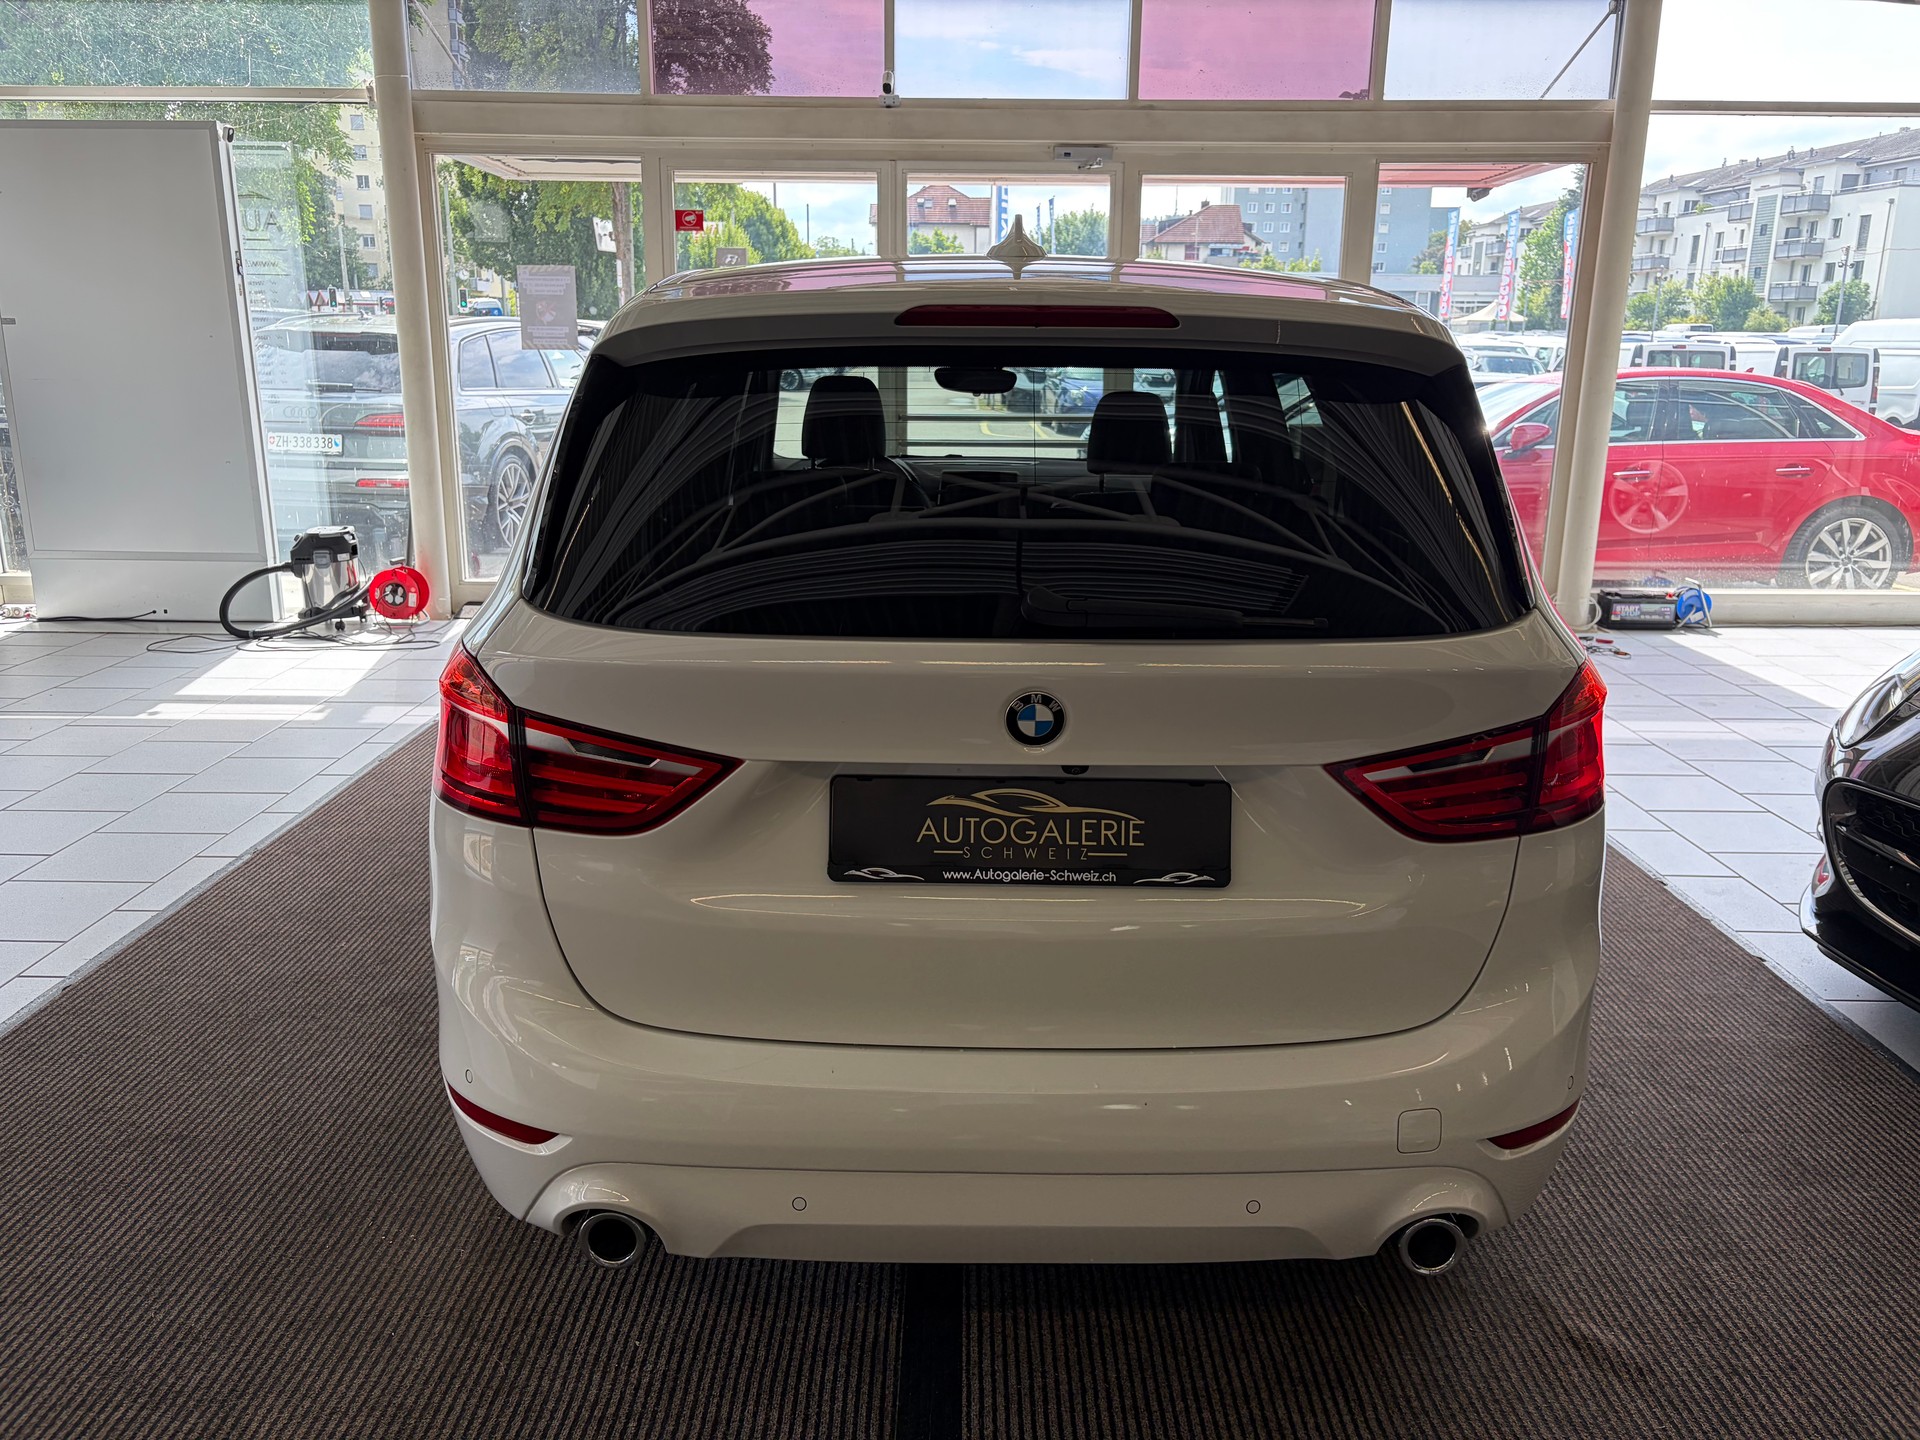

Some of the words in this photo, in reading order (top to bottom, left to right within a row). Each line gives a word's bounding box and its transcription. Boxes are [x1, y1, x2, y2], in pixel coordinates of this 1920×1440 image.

[1011, 694, 1061, 712] BMW
[916, 817, 1145, 846] AUTOGALERIE
[963, 846, 1087, 860] SCHWEIZ
[942, 868, 1117, 883] www.Autogalerie-Schweiz.ch
